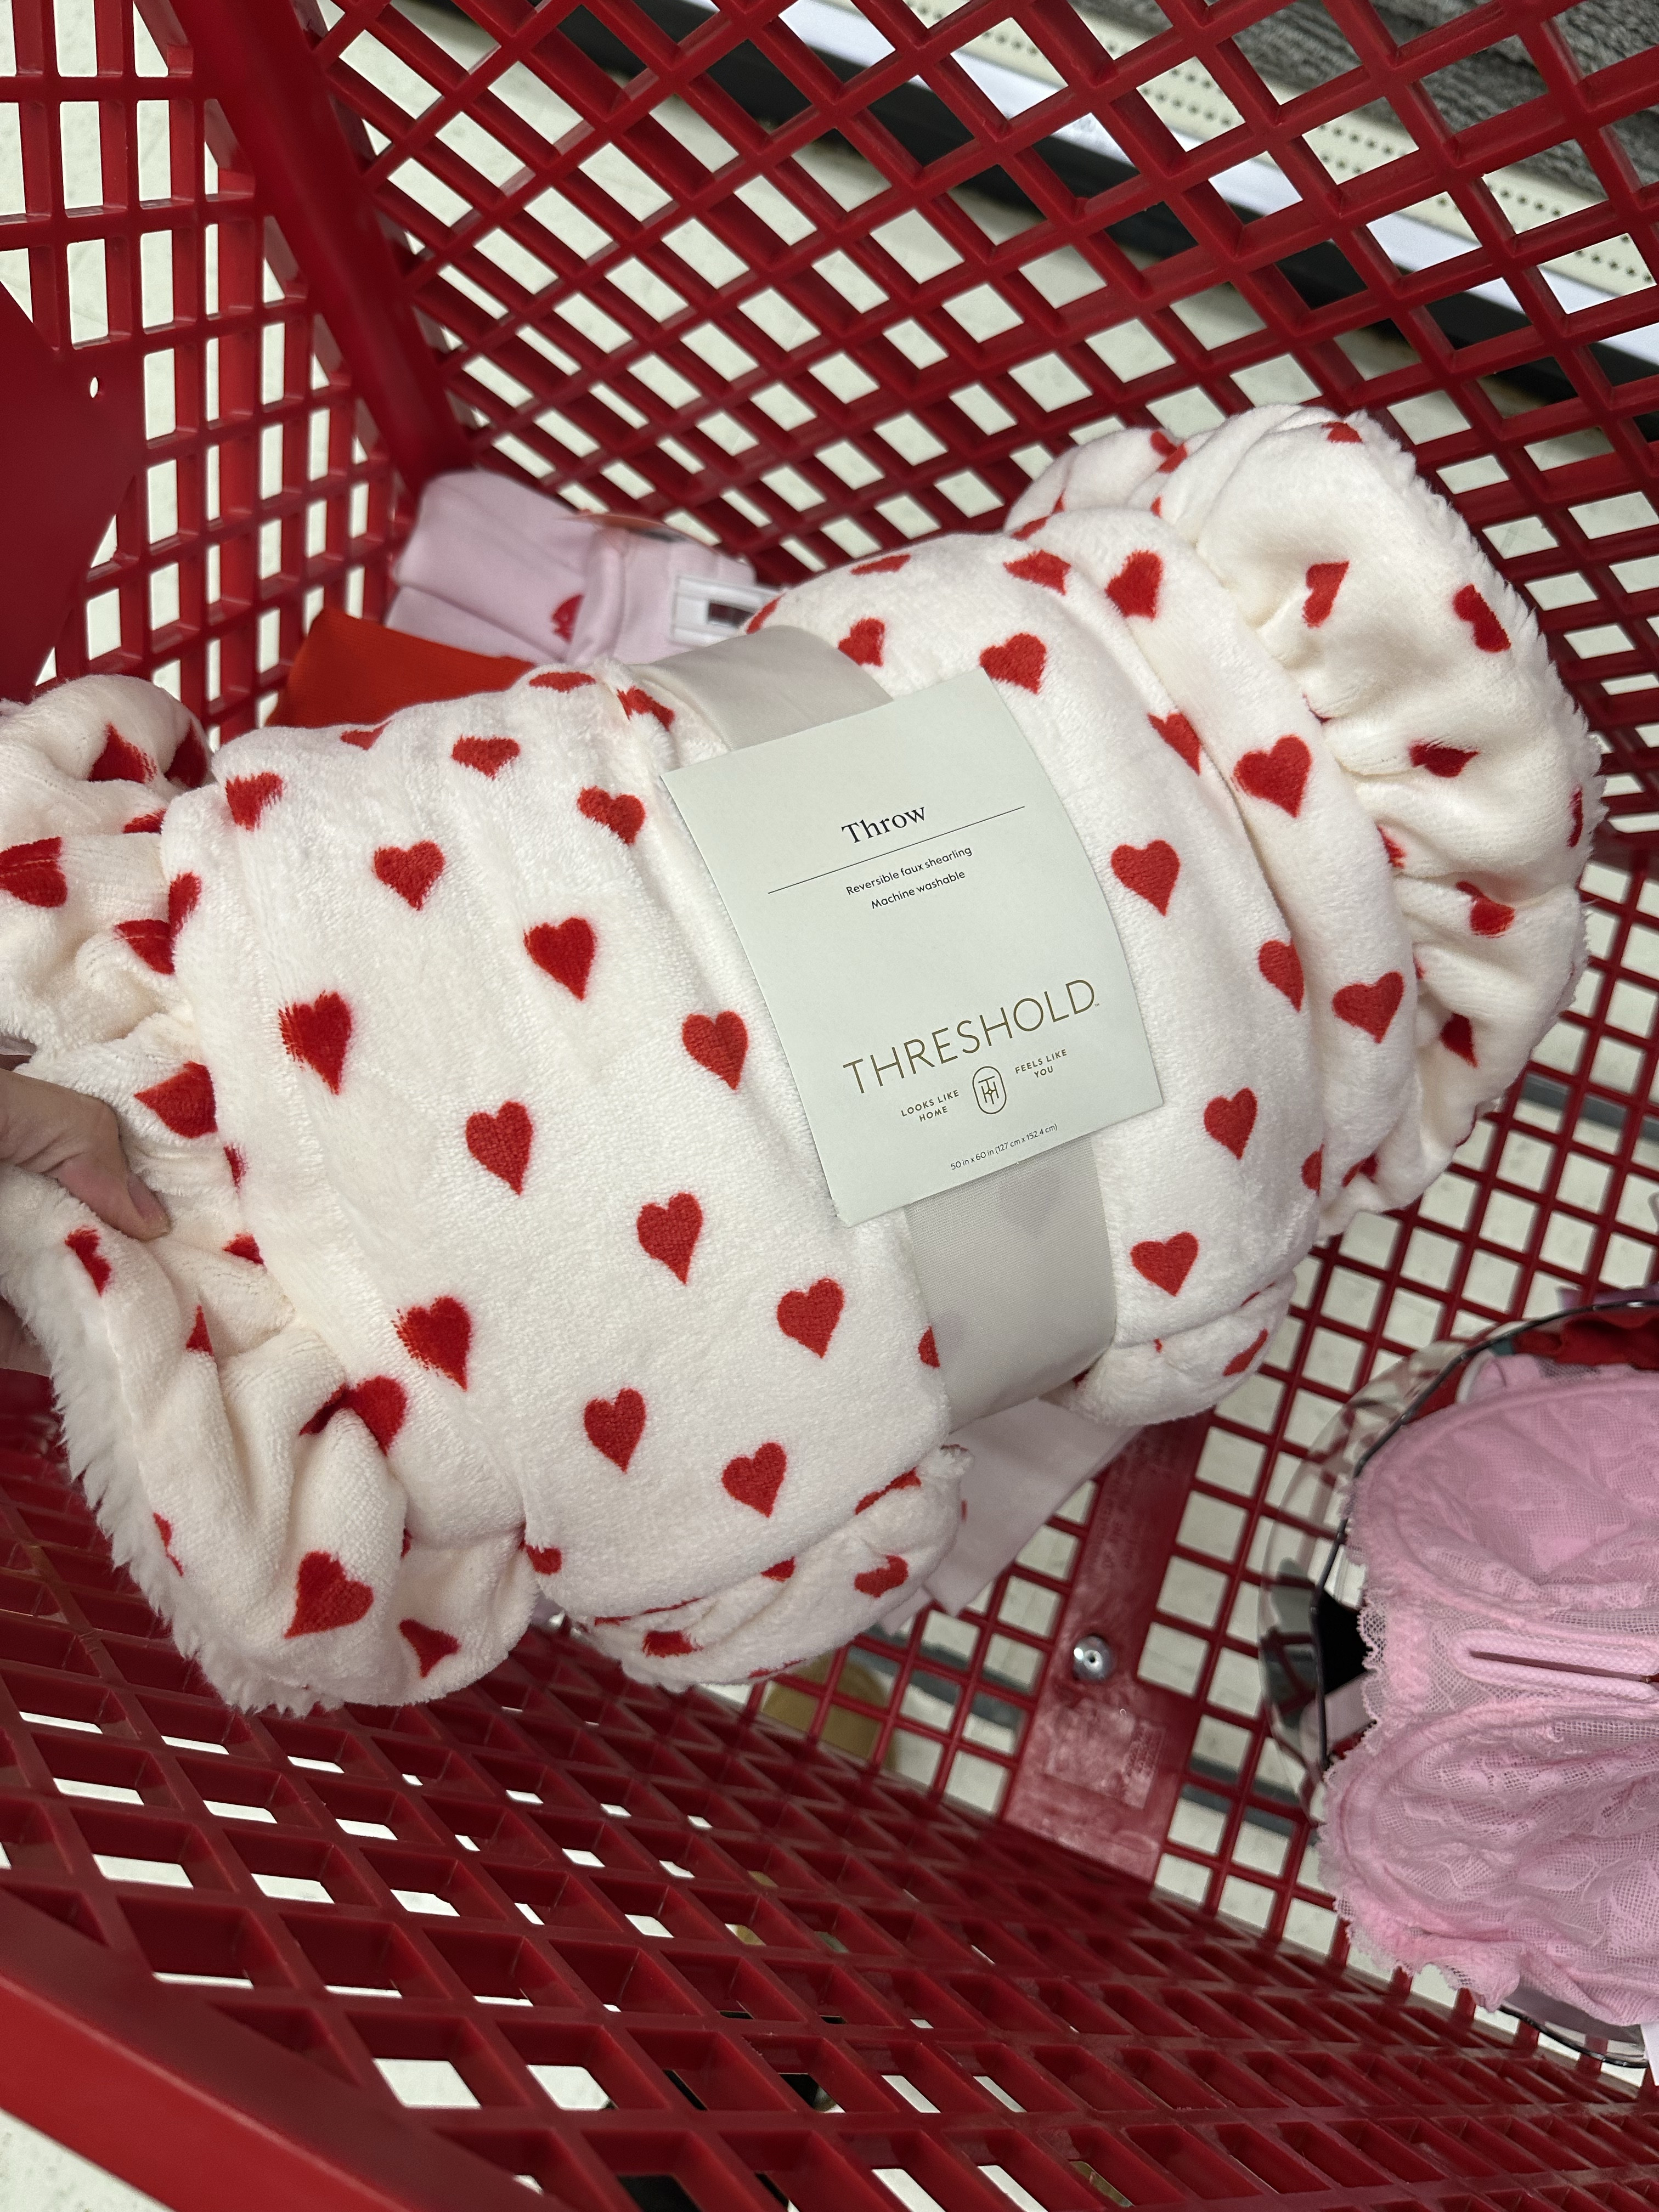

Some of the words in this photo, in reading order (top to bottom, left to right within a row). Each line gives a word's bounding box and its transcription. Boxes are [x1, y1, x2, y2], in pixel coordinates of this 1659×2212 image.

[840, 806, 926, 844] Throw
[845, 871, 900, 895] Reversible
[900, 864, 924, 877] faux
[925, 847, 973, 868] shearling
[871, 889, 916, 910] Machine
[916, 871, 966, 893] washable
[1014, 1058, 1043, 1074] FEELS
[1046, 1048, 1068, 1063] LIKE
[1033, 1065, 1054, 1079] YOU
[901, 1099, 935, 1117] LOOKS
[937, 1089, 960, 1104] LIKE
[918, 1105, 949, 1122] HOME
[950, 1160, 962, 1170] 50
[975, 1151, 986, 1161] 60
[995, 1142, 1008, 1155] (127
[1010, 1139, 1021, 1147] cm
[1026, 1128, 1044, 1141] 152.4
[1045, 1123, 1058, 1133] cm)
